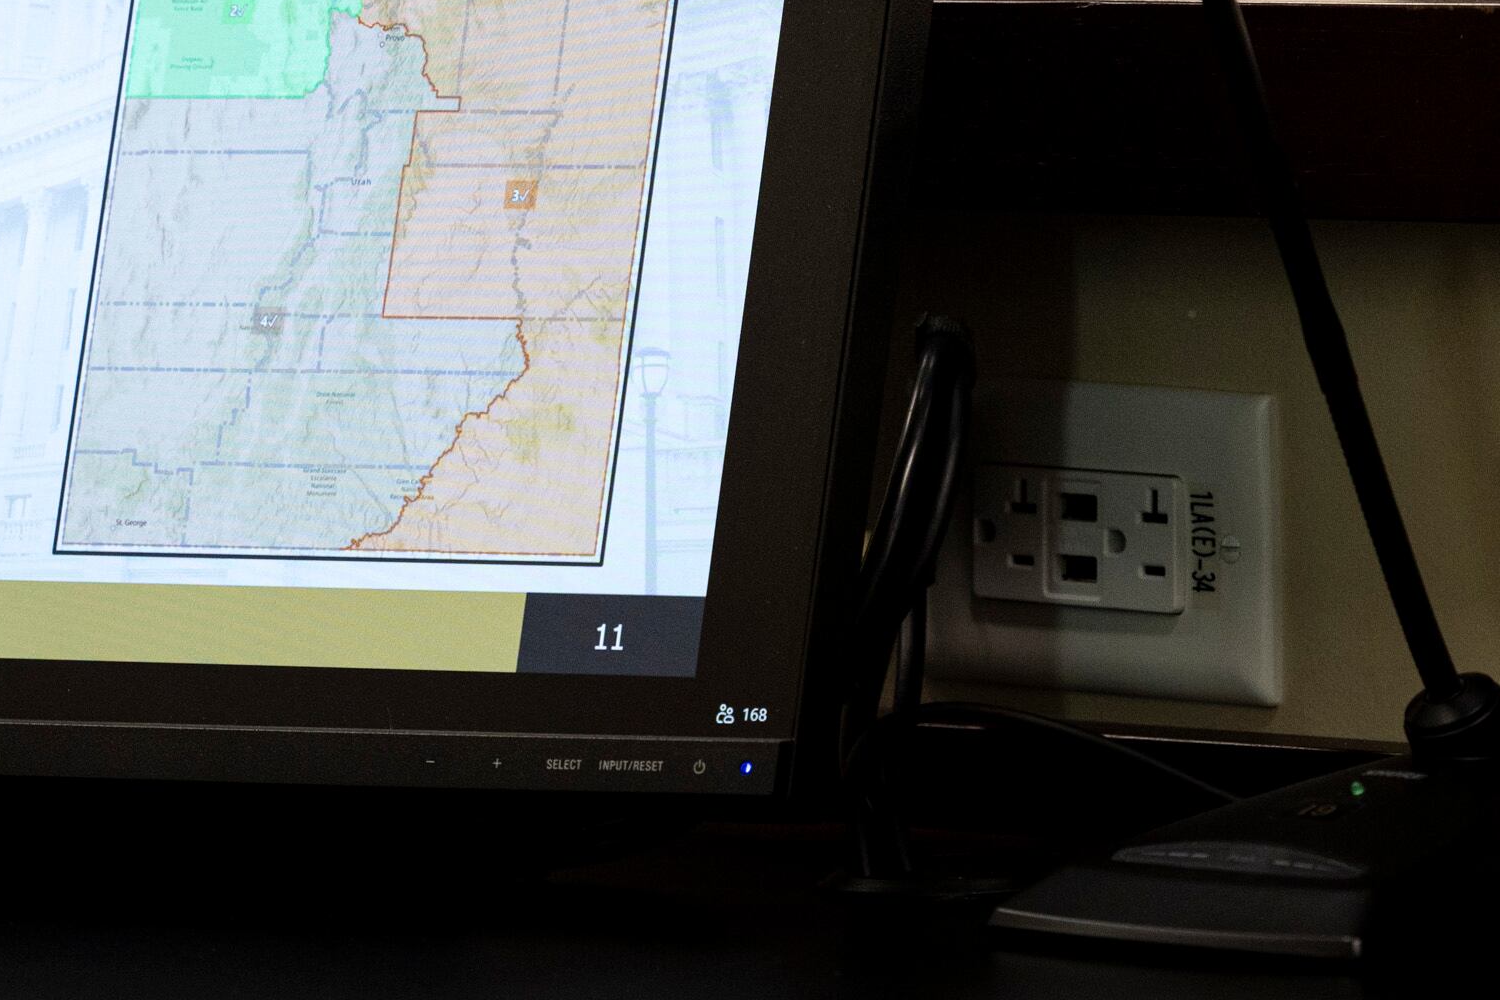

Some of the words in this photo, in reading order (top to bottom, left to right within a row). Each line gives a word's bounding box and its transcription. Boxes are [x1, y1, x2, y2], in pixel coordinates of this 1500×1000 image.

[1190, 491, 1217, 593] 1LA(E)-34
[594, 623, 625, 651] 11
[742, 707, 768, 722] 168
[546, 758, 582, 771] SELECT
[599, 760, 664, 773] INPUT/RESET
